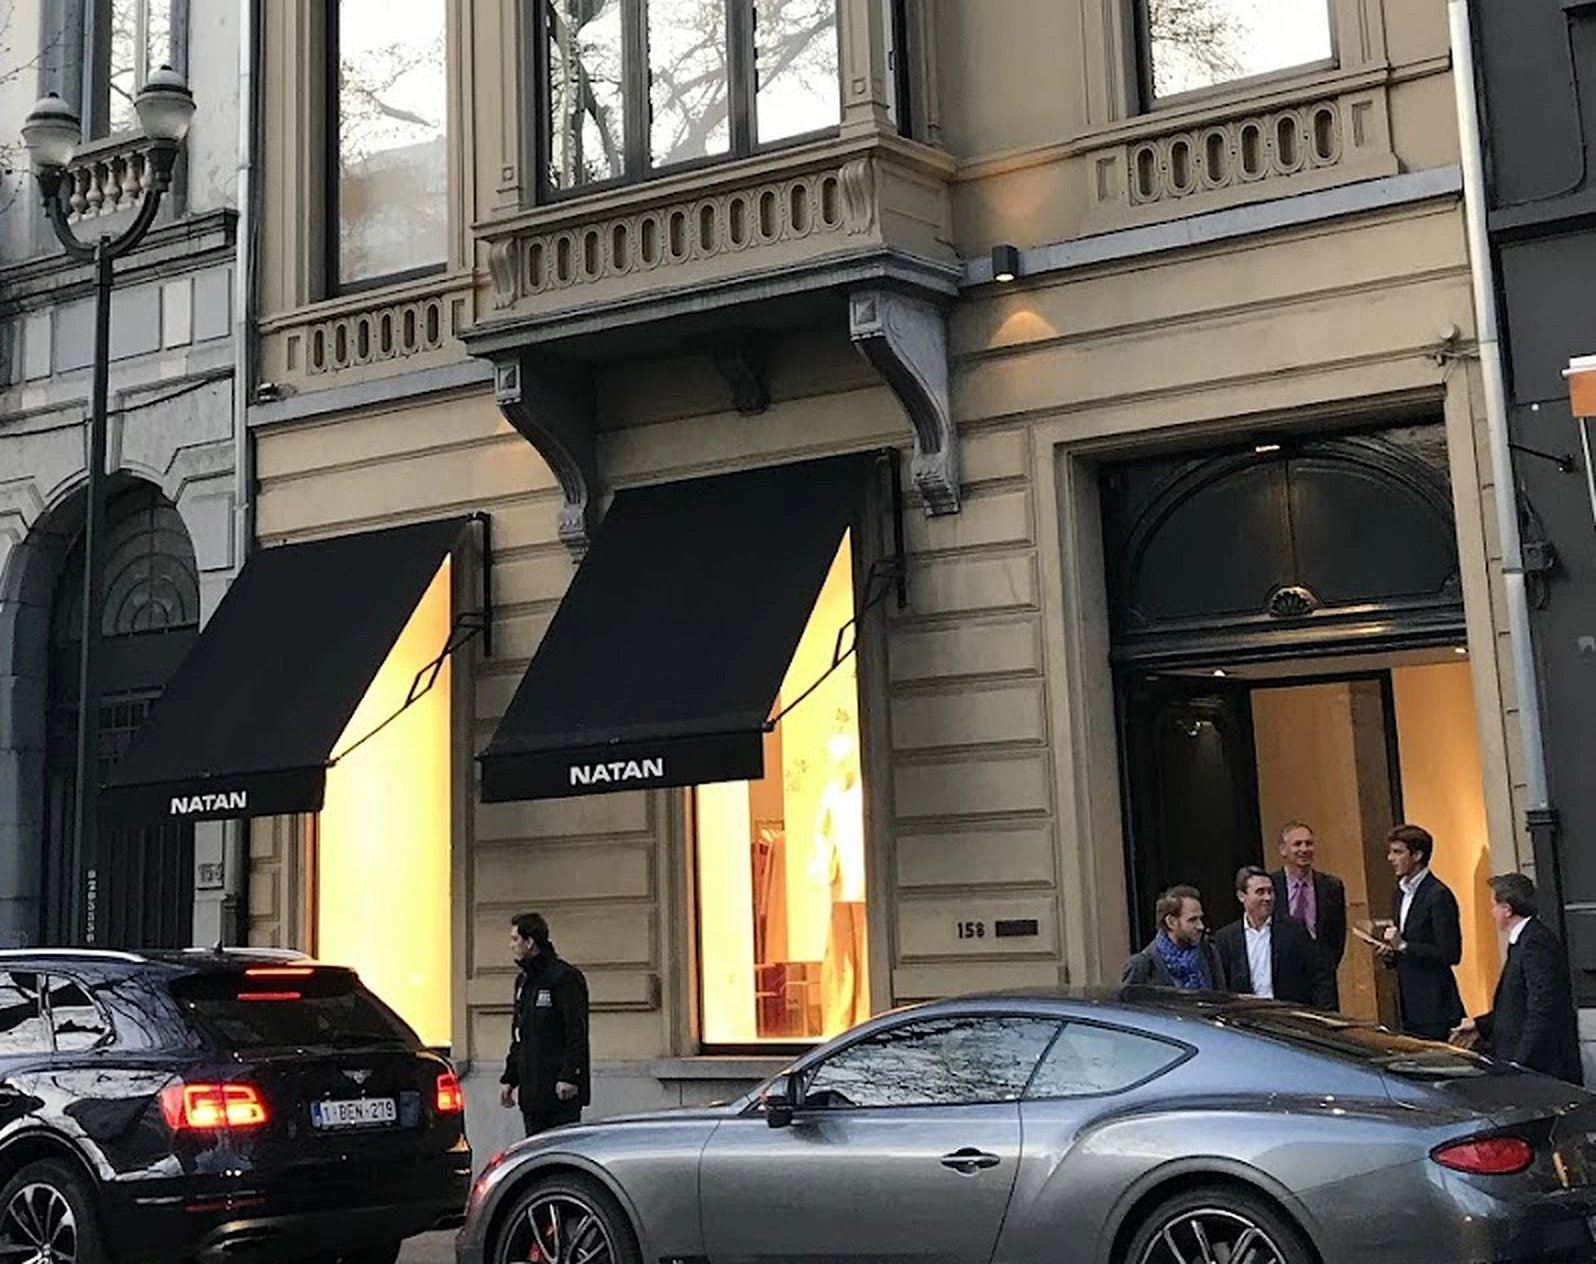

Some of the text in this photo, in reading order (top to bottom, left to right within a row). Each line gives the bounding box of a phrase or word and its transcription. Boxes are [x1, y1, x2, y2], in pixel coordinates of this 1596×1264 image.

[569, 757, 664, 786] NATAN
[170, 790, 247, 815] NATAN
[957, 921, 985, 938] 158
